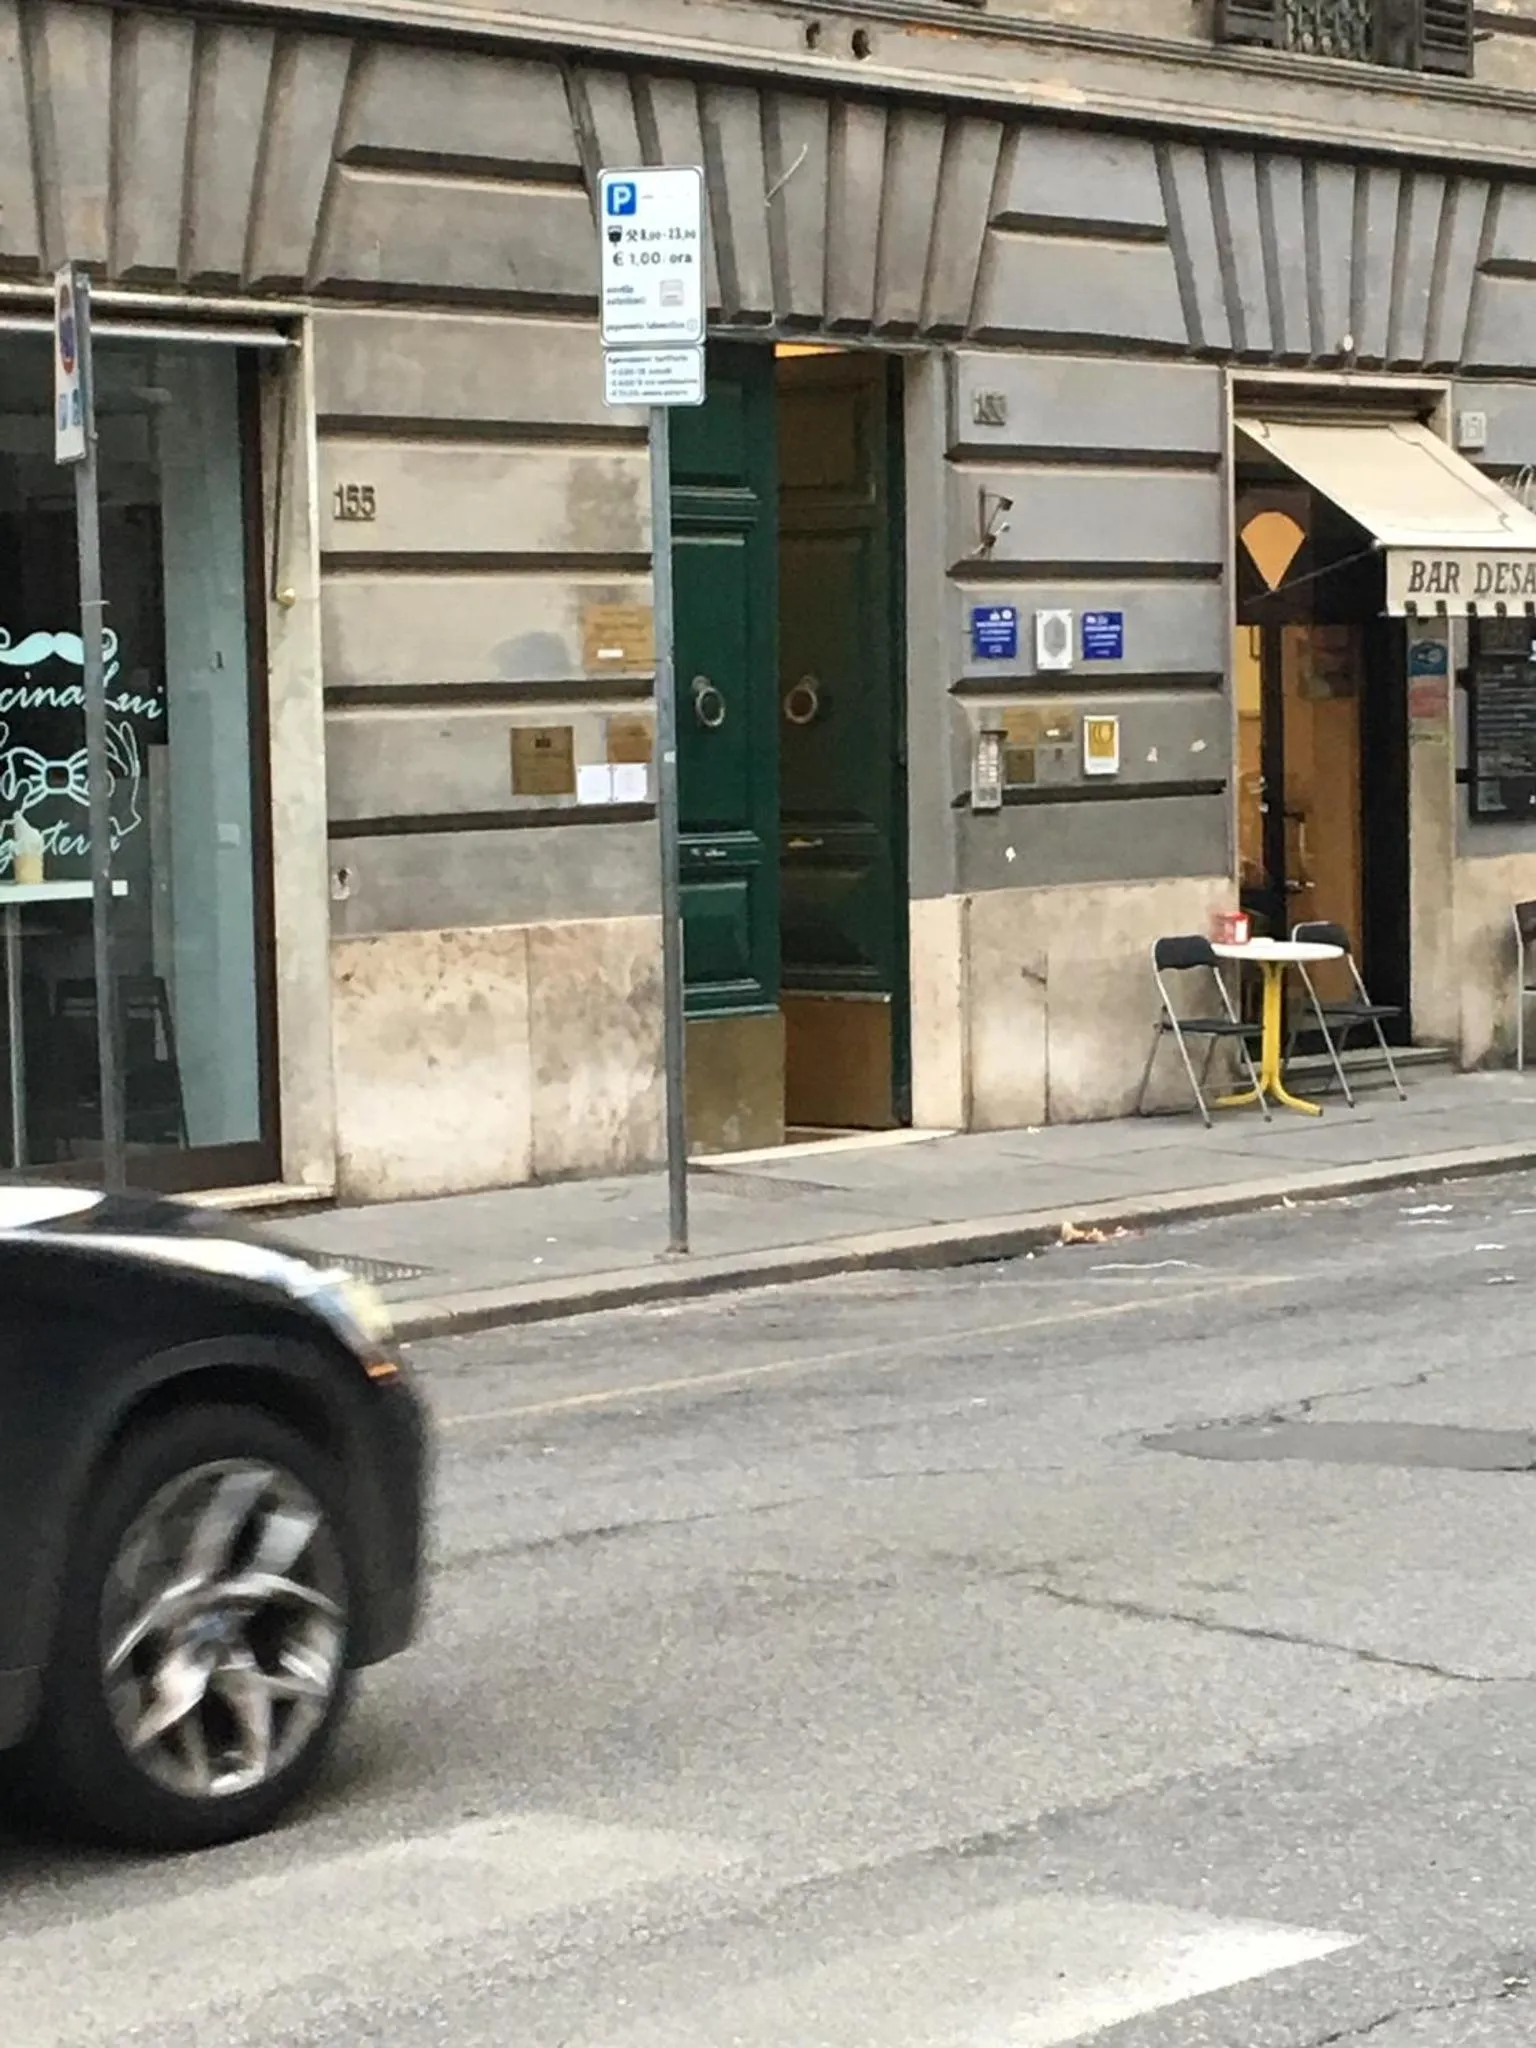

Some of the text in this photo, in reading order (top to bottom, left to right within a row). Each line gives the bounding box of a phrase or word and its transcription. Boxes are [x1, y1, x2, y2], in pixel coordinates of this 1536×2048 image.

[613, 185, 632, 213] P
[669, 252, 693, 264] ora
[333, 483, 376, 520] 155
[1408, 560, 1460, 594] BAR
